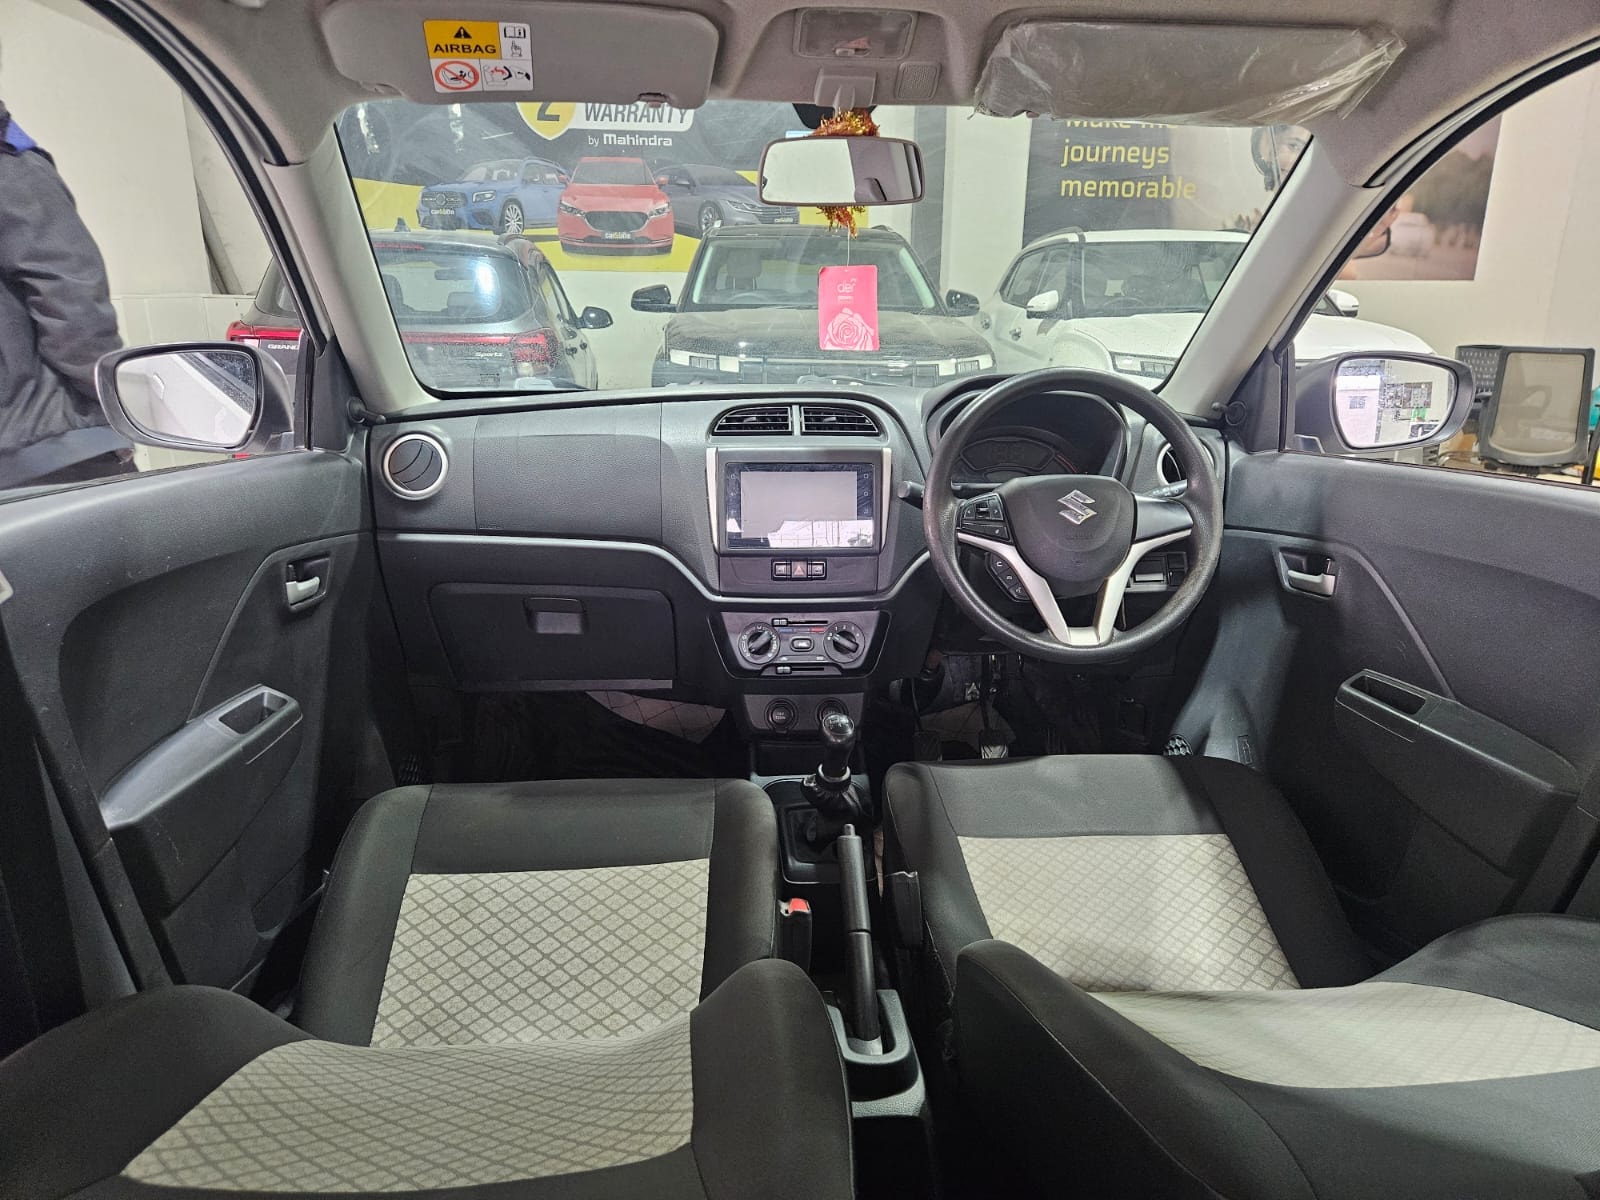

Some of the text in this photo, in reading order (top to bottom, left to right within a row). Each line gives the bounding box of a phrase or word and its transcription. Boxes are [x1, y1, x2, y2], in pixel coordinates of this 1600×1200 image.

[433, 43, 497, 54] AIRBAG
[585, 103, 688, 124] WARRANTY
[588, 133, 673, 147] by Mahindra
[1060, 138, 1169, 169] journeys
[1060, 175, 1197, 200] memorable
